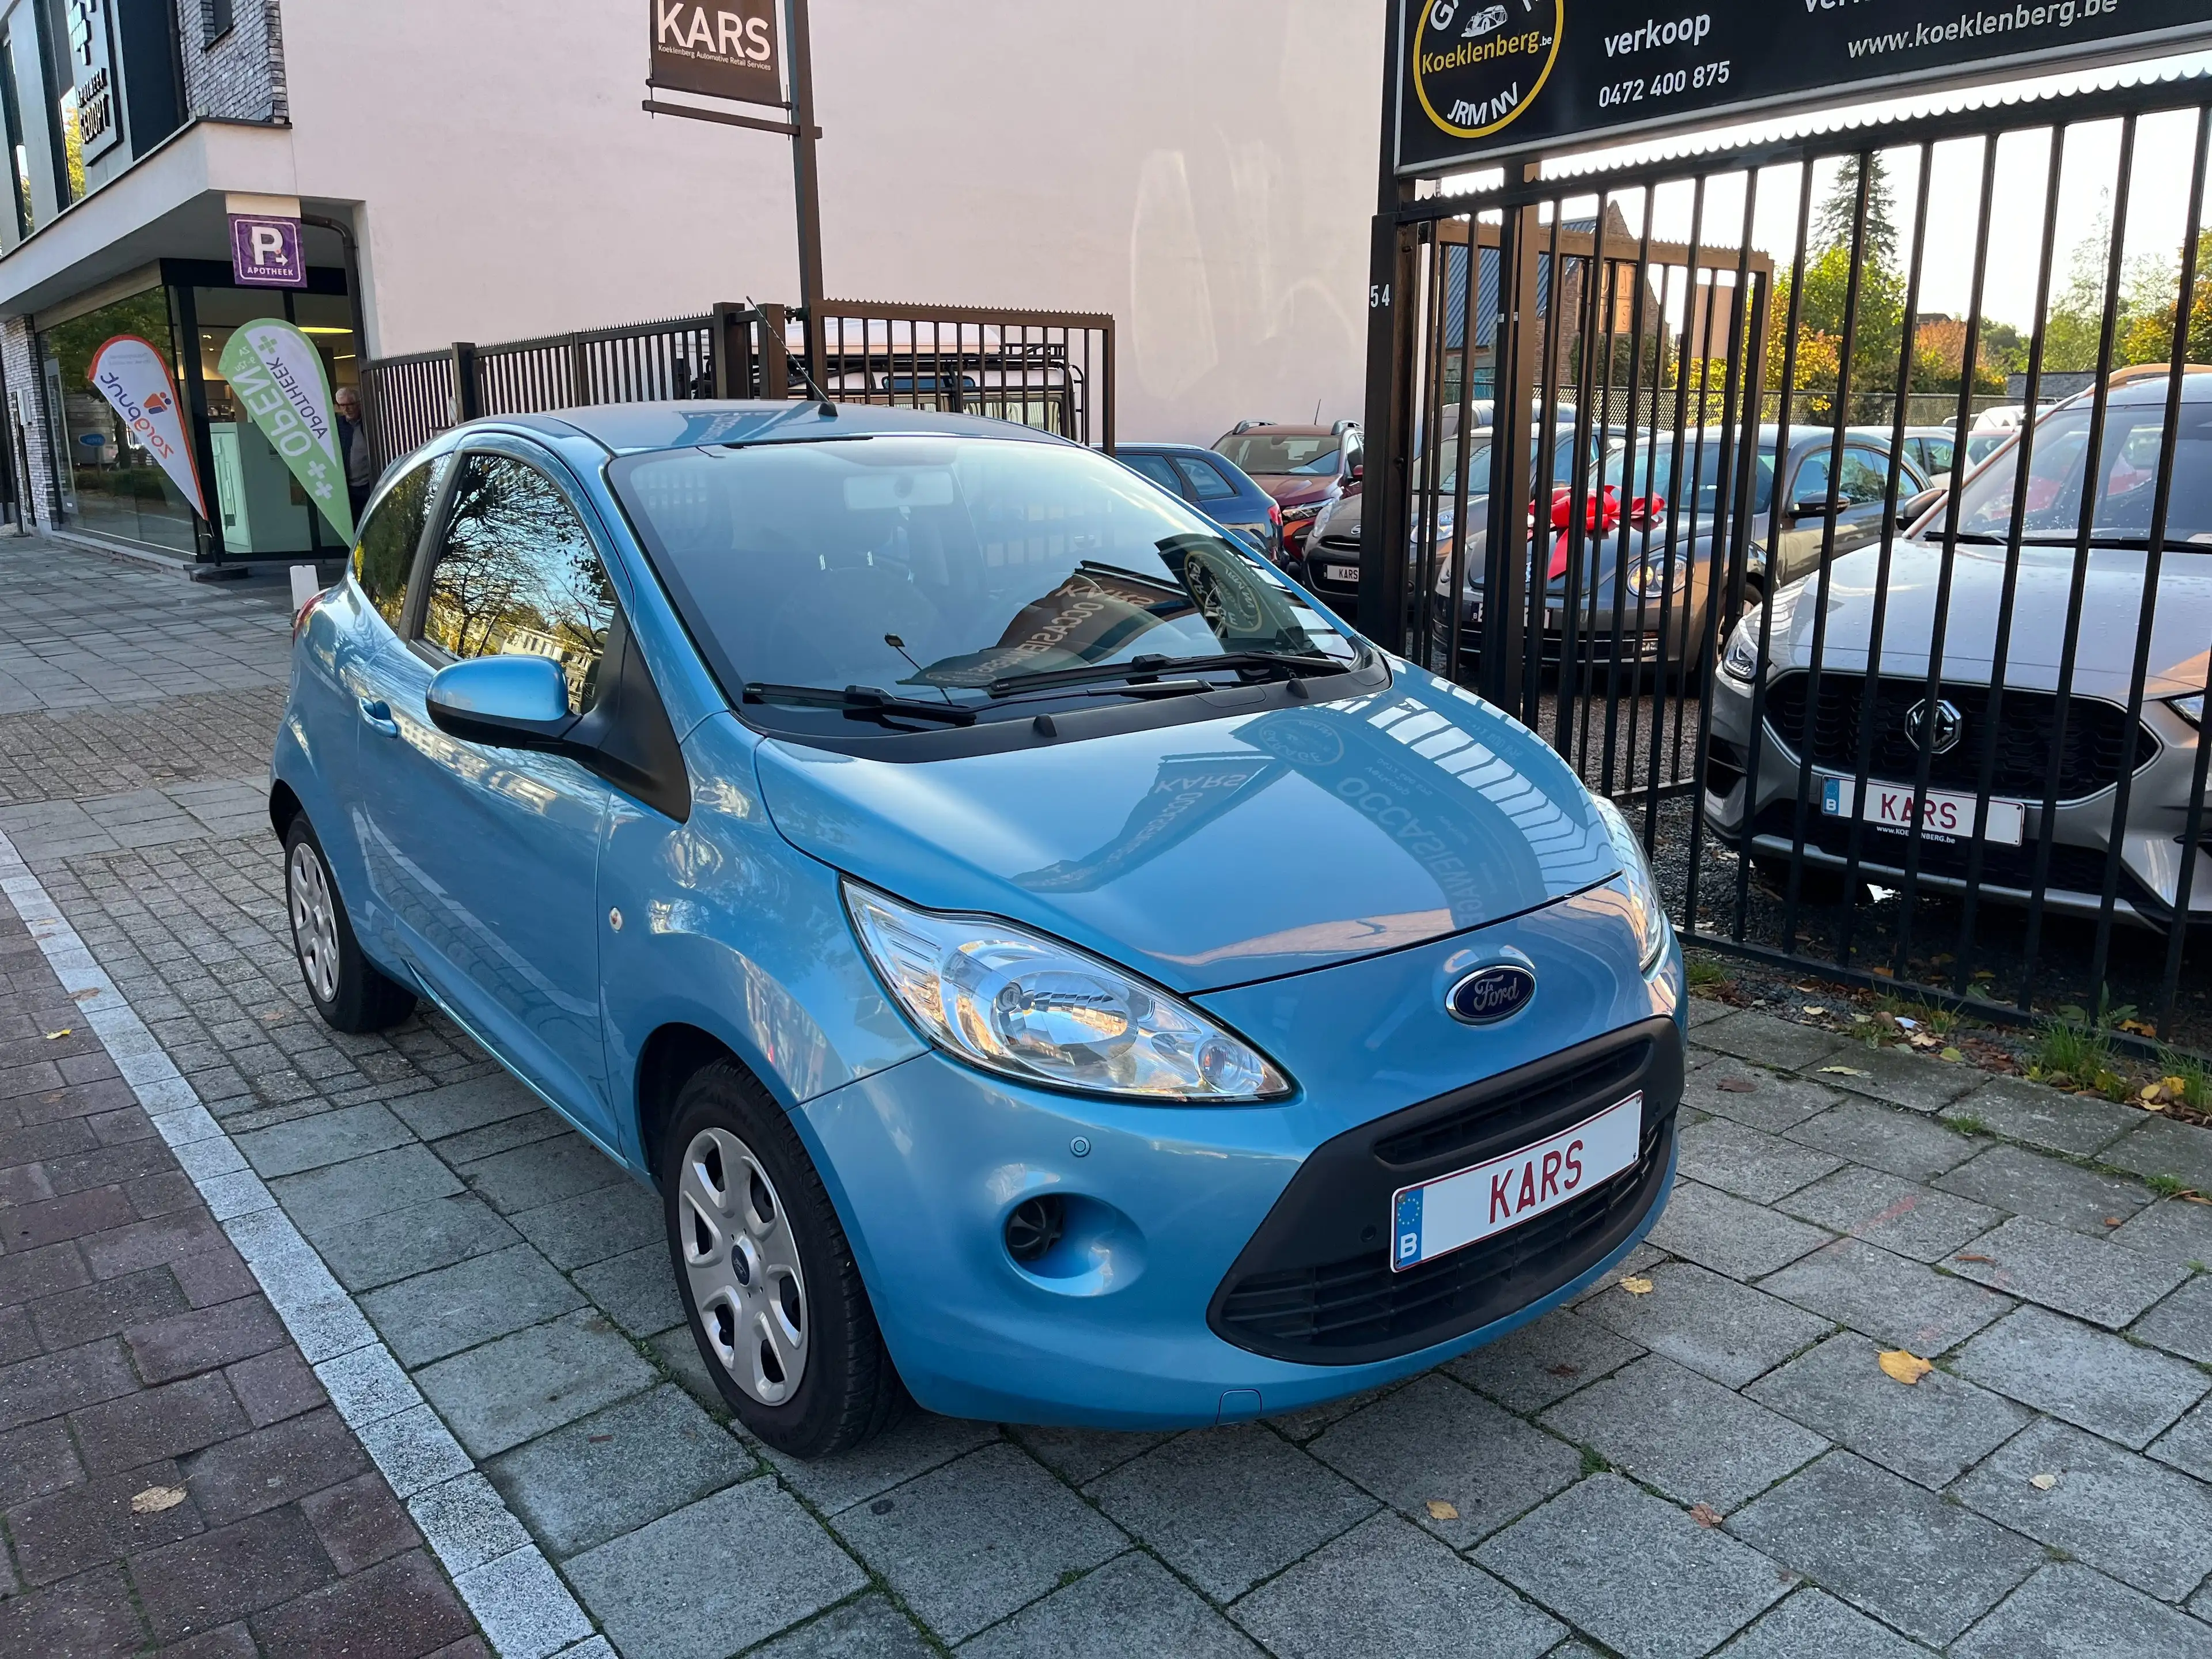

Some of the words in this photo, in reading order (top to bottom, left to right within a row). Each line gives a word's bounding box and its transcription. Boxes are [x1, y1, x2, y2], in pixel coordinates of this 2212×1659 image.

[657, 0, 771, 61] KARS
[1604, 14, 1711, 57] verkoop
[1848, 0, 2118, 58] www.koeklenberg.be
[658, 44, 695, 59] Koeklenberg
[696, 51, 729, 63] Automotive
[730, 56, 745, 66] Retail
[747, 60, 771, 70] Services
[1599, 79, 1645, 108] 0472
[1650, 70, 1686, 96] 400
[1692, 60, 1730, 89] 875
[1446, 99, 1488, 126] JRM
[1490, 81, 1518, 120] NV
[251, 226, 283, 265] P
[247, 267, 294, 276] APOTHEEK
[1370, 284, 1390, 308] 54
[1339, 569, 1358, 579] KARS
[1826, 798, 1836, 811] B
[1881, 793, 1957, 830] KARS
[1876, 825, 1956, 844] www.KOENBERG.be
[1473, 974, 1520, 1012] Ford
[1400, 1232, 1418, 1257] B
[1489, 1139, 1584, 1225] KARS
